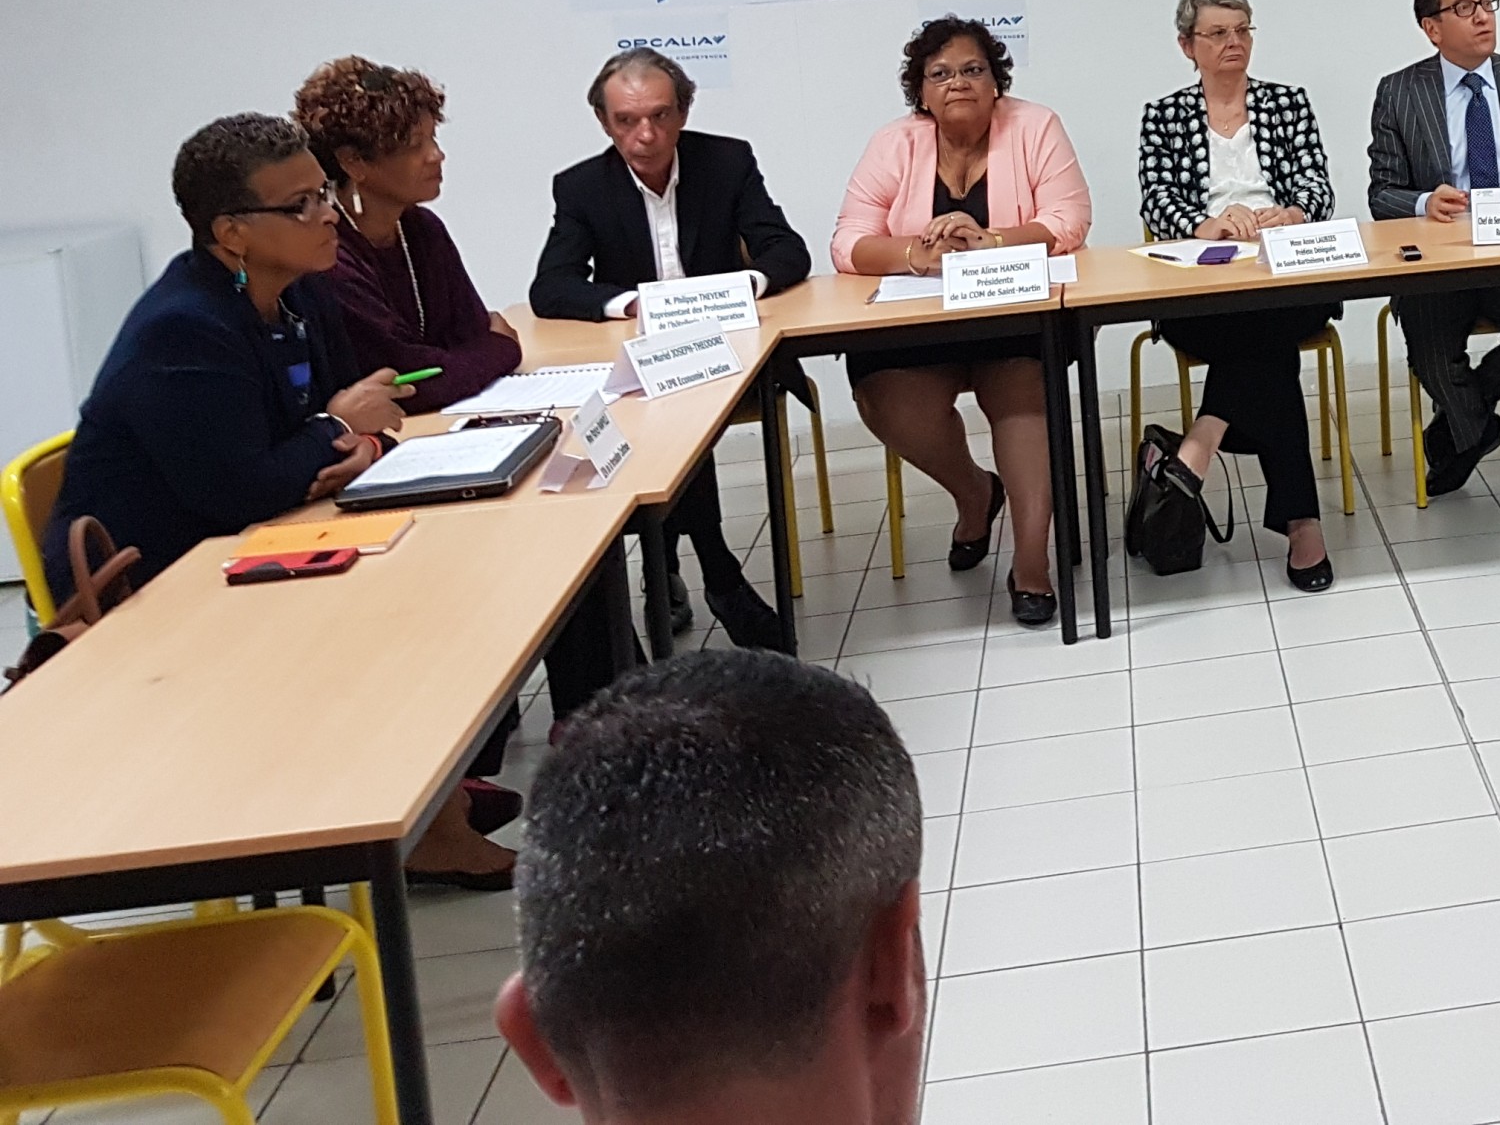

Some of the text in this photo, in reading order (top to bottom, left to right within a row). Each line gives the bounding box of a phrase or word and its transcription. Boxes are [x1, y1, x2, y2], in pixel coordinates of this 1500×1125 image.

[618, 35, 713, 49] OPCALIA
[962, 262, 1030, 277] Mme Aline HANSON
[977, 276, 1014, 287] Présidente
[950, 284, 1041, 301] de la COM de Saint-Martin
